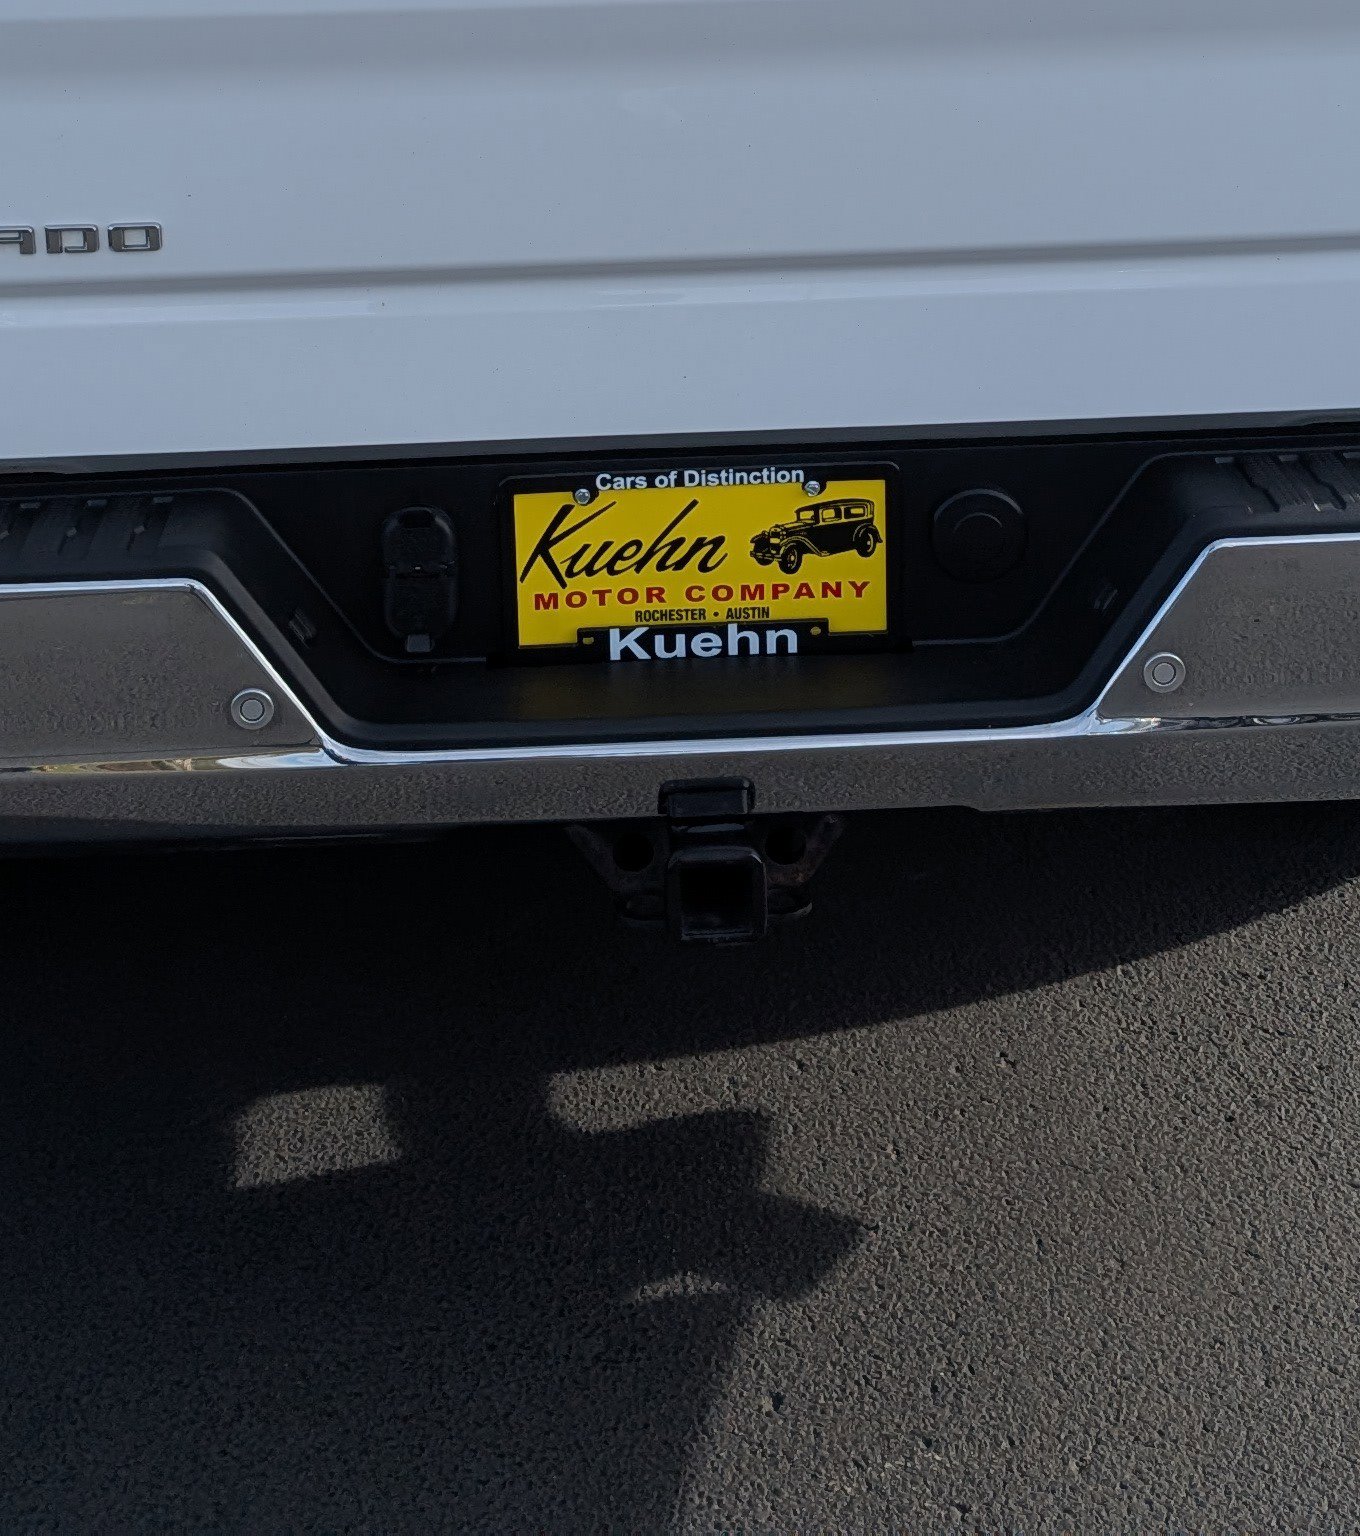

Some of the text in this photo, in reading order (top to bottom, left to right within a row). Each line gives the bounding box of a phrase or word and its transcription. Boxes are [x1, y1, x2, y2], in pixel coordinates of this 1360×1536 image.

[595, 467, 805, 491] Cars of Distinction
[520, 499, 729, 589] Kuehn
[534, 580, 871, 611] MOTOR COMPANY
[634, 606, 771, 623] ROCHESTER AUSTIN
[609, 622, 799, 661] Kuehn
